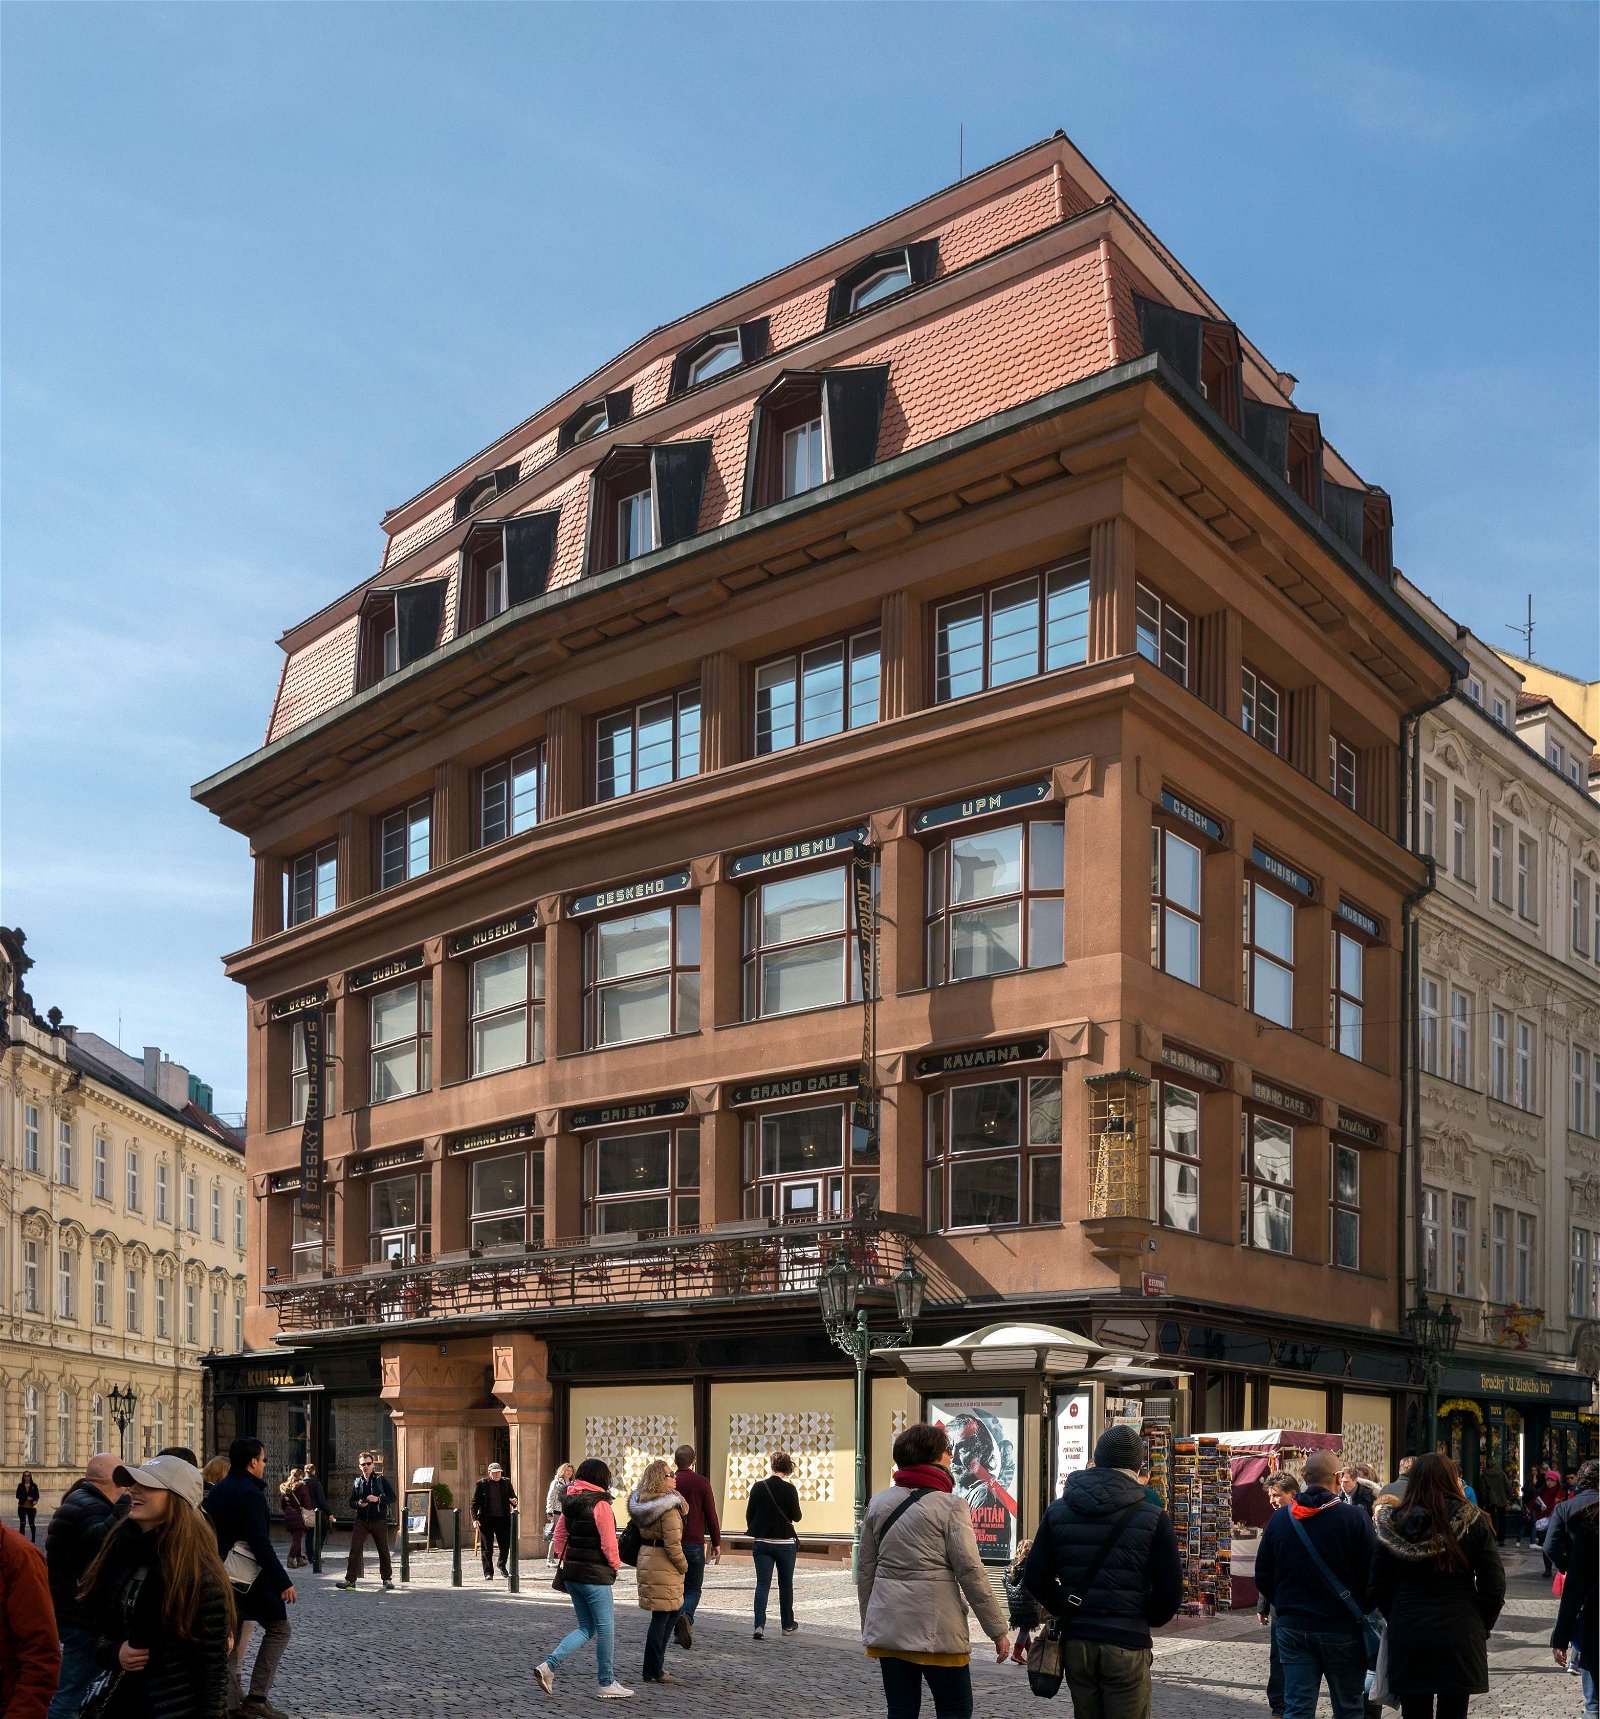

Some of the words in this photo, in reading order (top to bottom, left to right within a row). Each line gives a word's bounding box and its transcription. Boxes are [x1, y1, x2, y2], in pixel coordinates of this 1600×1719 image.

[961, 794, 1002, 817] UPM
[1173, 799, 1208, 831] CZECH
[762, 836, 836, 867] KUBISMU
[473, 920, 517, 946] MUSEUM
[372, 960, 407, 981] CUBISM
[1170, 1050, 1209, 1076] ORIENT
[750, 1080, 802, 1100] GRAND
[807, 1073, 848, 1091] CAFE
[601, 1103, 657, 1122] ORIENT
[247, 1369, 294, 1386] KUBISTA
[970, 1503, 1005, 1523] APITÁN
